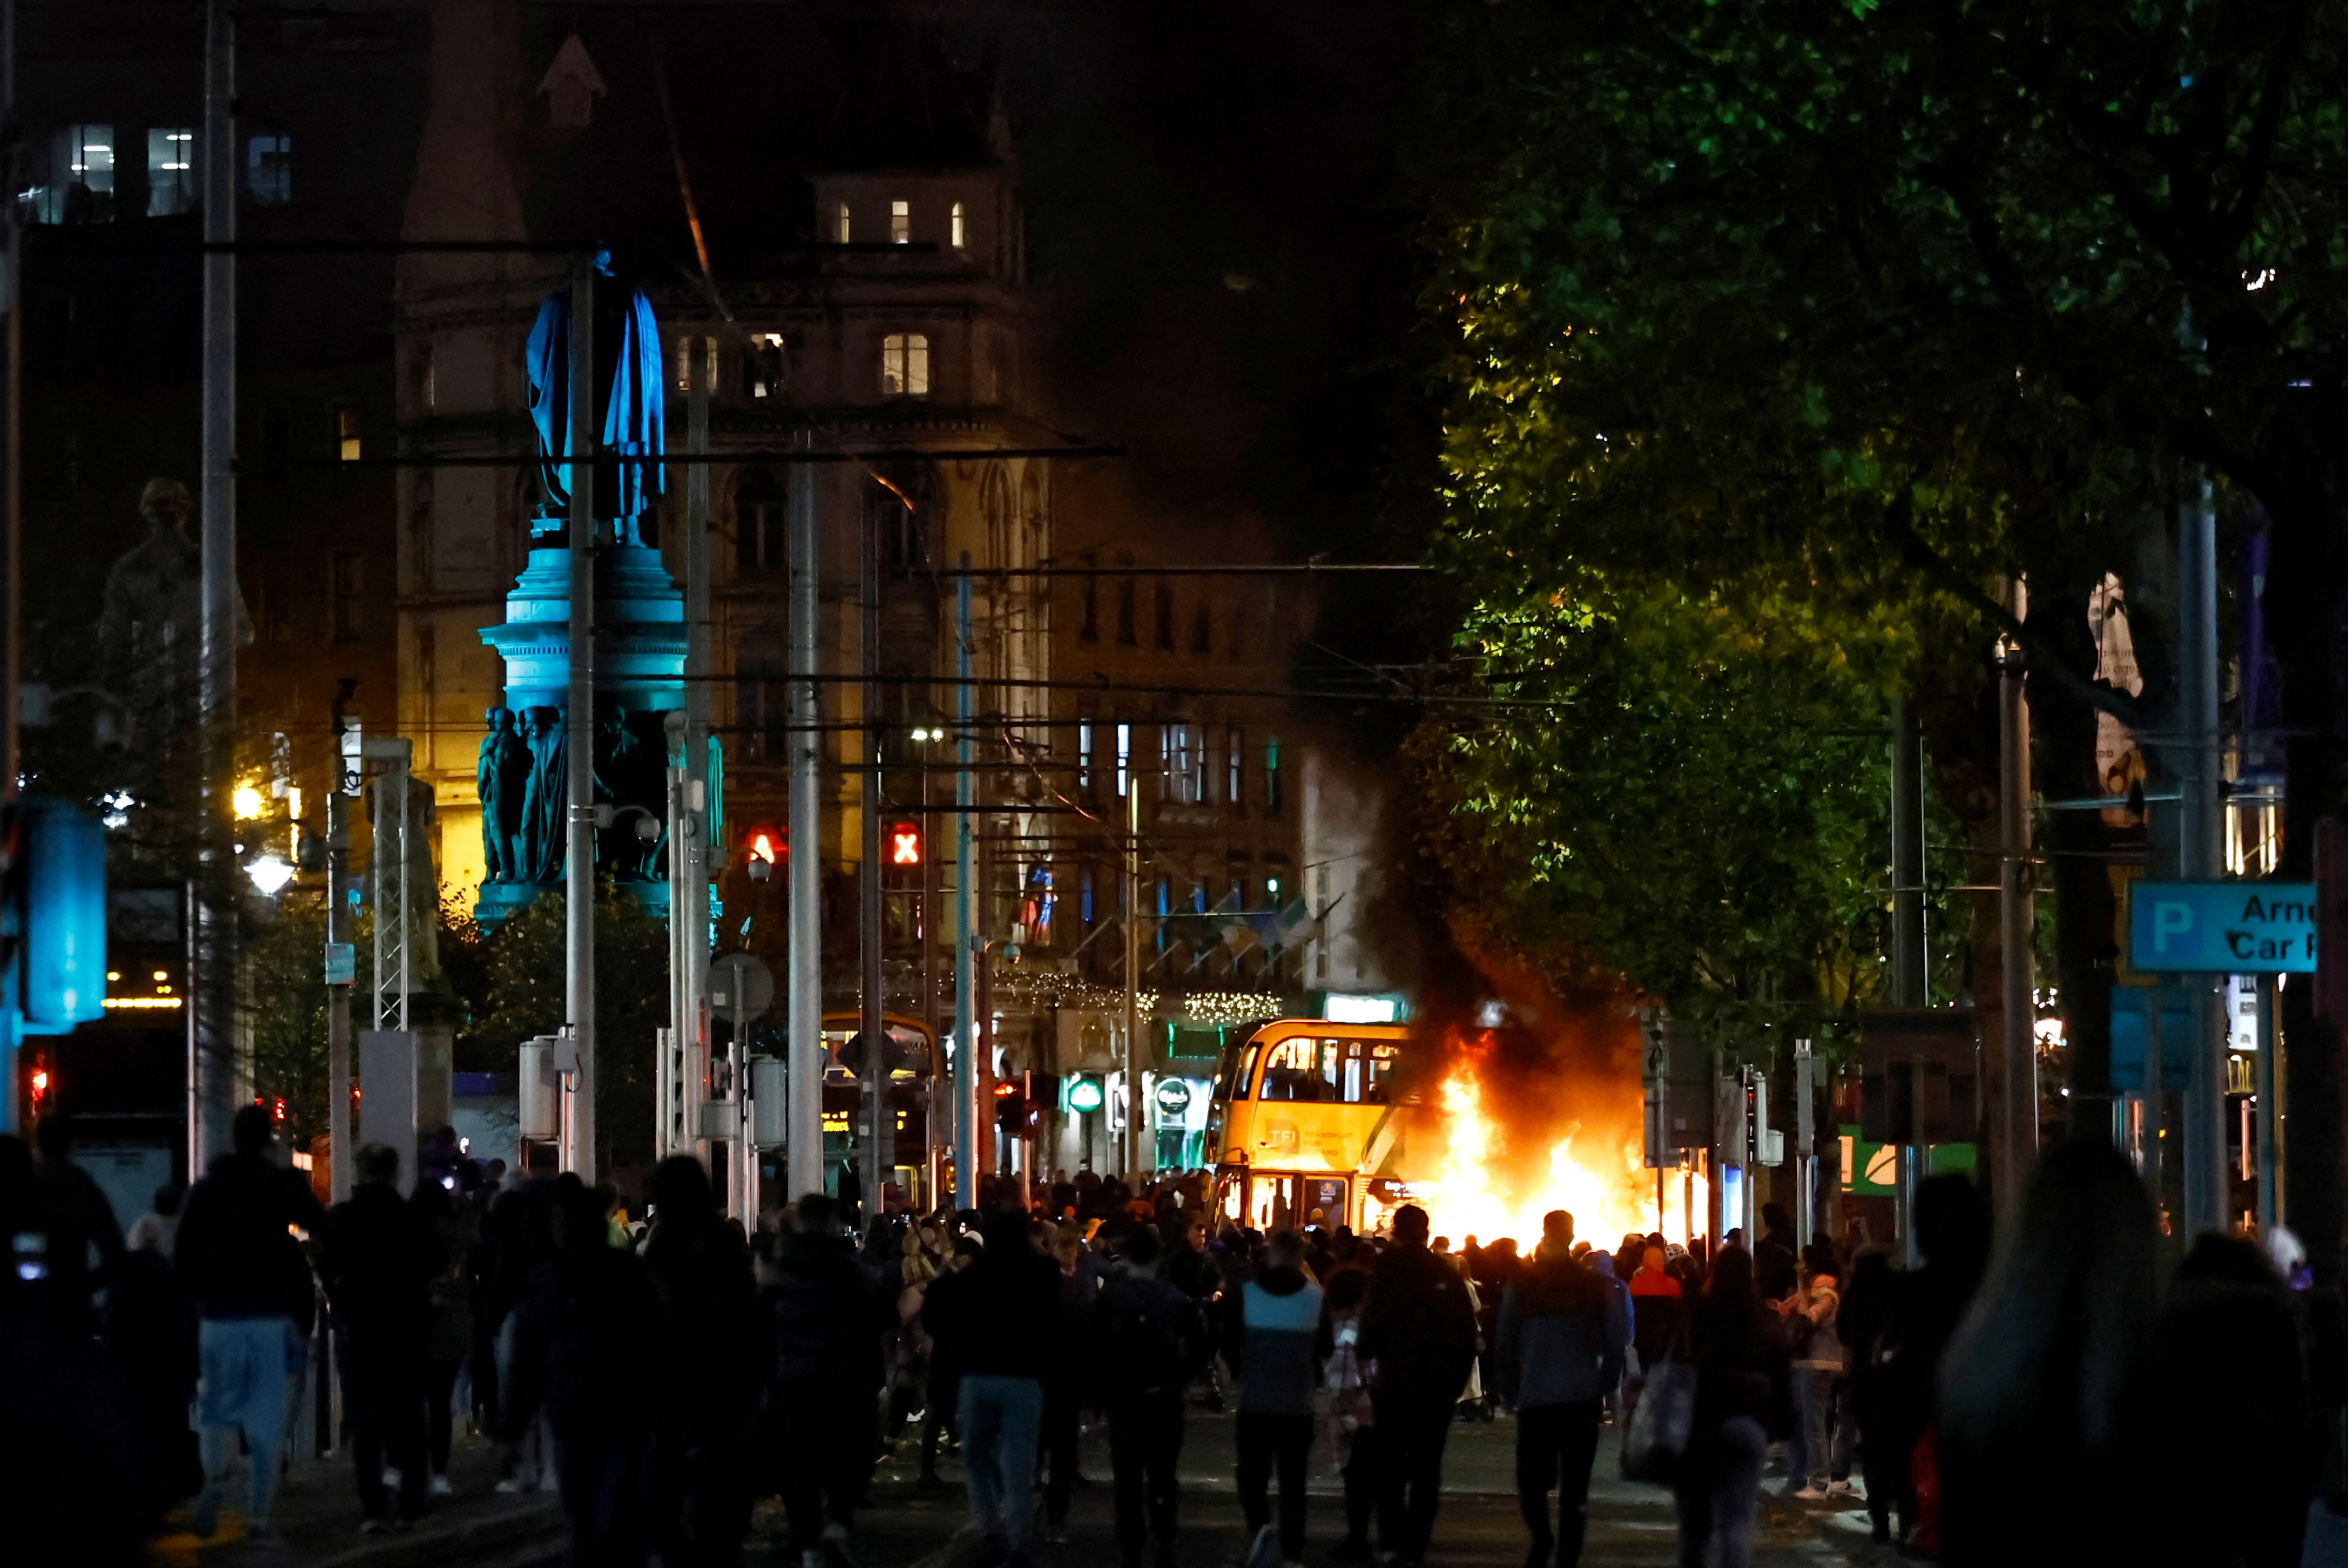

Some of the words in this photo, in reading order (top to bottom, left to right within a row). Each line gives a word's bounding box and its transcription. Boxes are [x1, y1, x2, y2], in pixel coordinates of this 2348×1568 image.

[2153, 901, 2194, 953] P
[2228, 931, 2293, 959] Car
[1270, 1130, 1296, 1143] TFI
